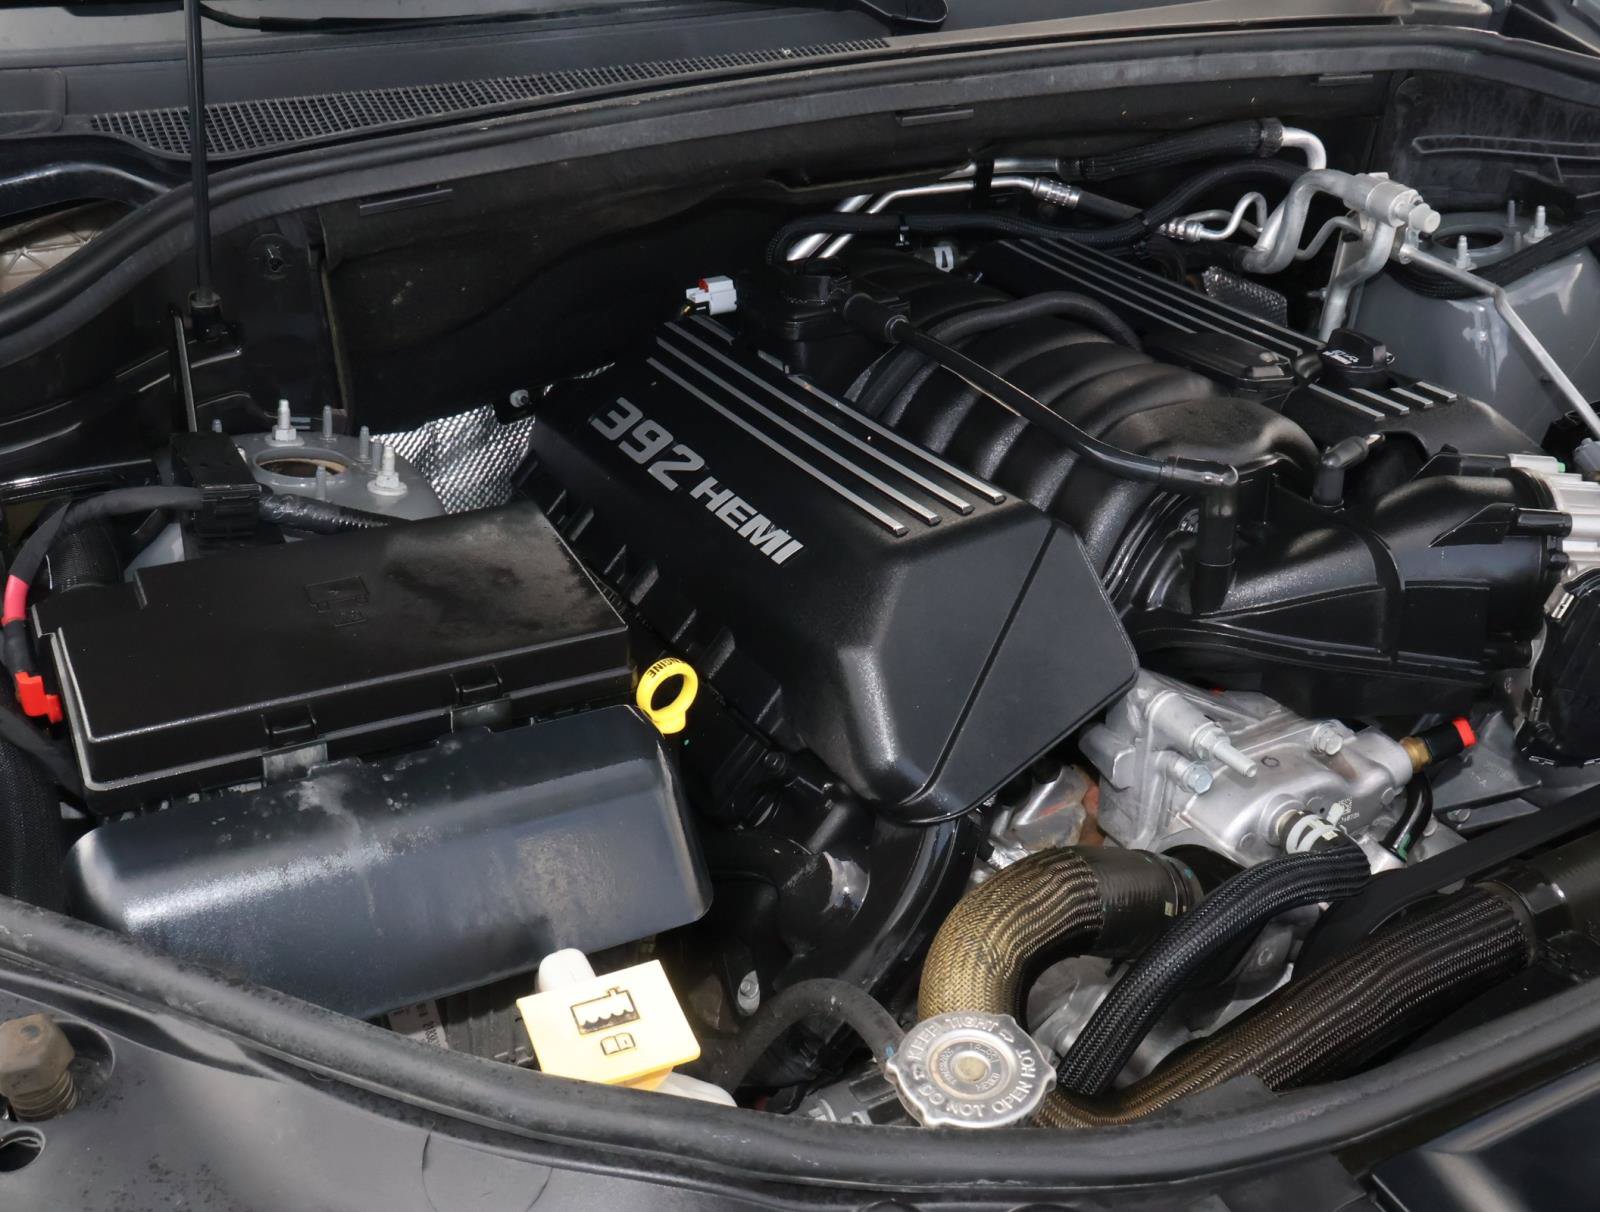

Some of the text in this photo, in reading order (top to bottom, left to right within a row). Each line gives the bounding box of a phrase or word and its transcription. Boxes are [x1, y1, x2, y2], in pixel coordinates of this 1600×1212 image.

[590, 397, 804, 565] 392 HEMI
[908, 1024, 939, 1061] KEEP
[945, 1016, 999, 1031] TIGHT
[918, 1084, 945, 1105] DO
[946, 1103, 984, 1117] NOT
[992, 1080, 1033, 1113] OPEN
[1016, 1049, 1036, 1078] HOT
